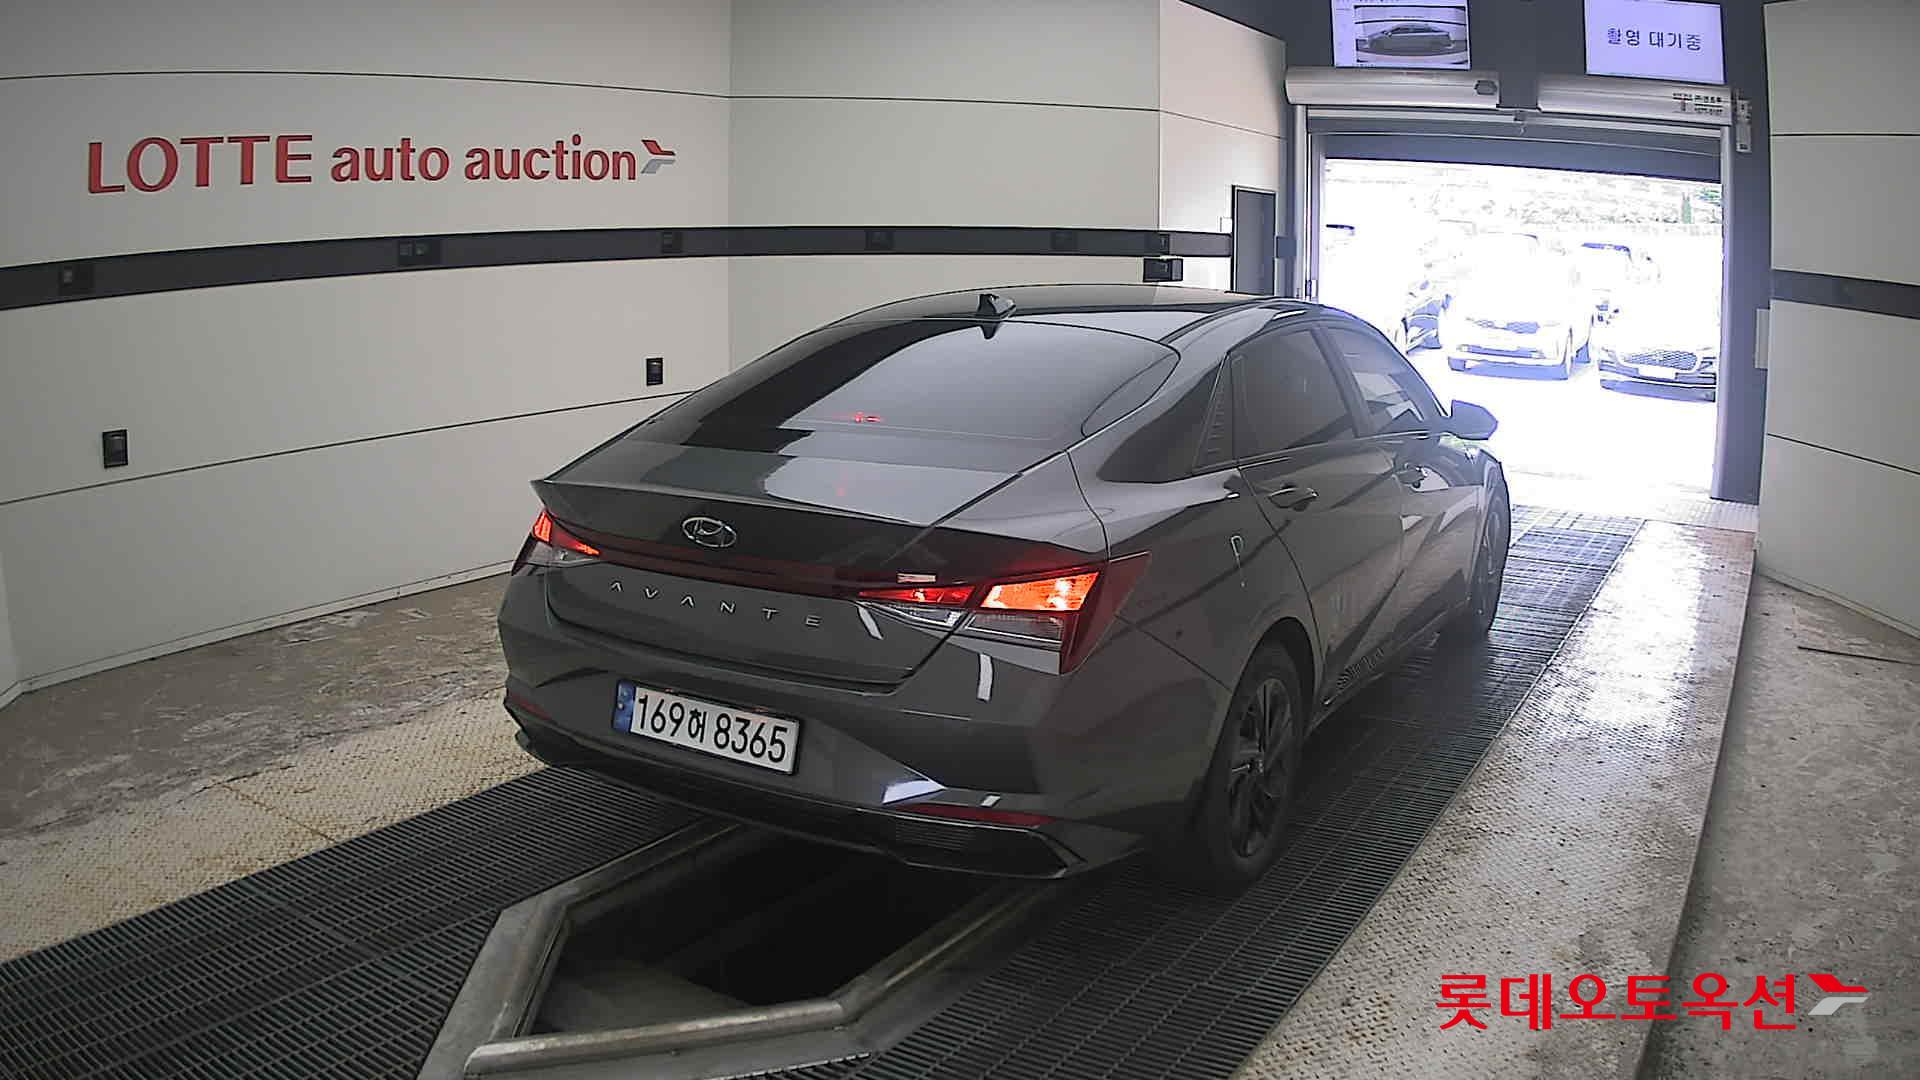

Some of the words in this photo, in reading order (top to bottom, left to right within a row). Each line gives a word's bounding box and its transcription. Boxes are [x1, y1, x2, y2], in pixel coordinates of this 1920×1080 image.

[1649, 31, 1702, 51] 대기중
[88, 135, 313, 194] LOTTE
[331, 138, 450, 182] auto
[464, 134, 637, 181] auction
[611, 581, 821, 627] AVANTE
[638, 694, 707, 743] 169허
[714, 713, 788, 763] 8365
